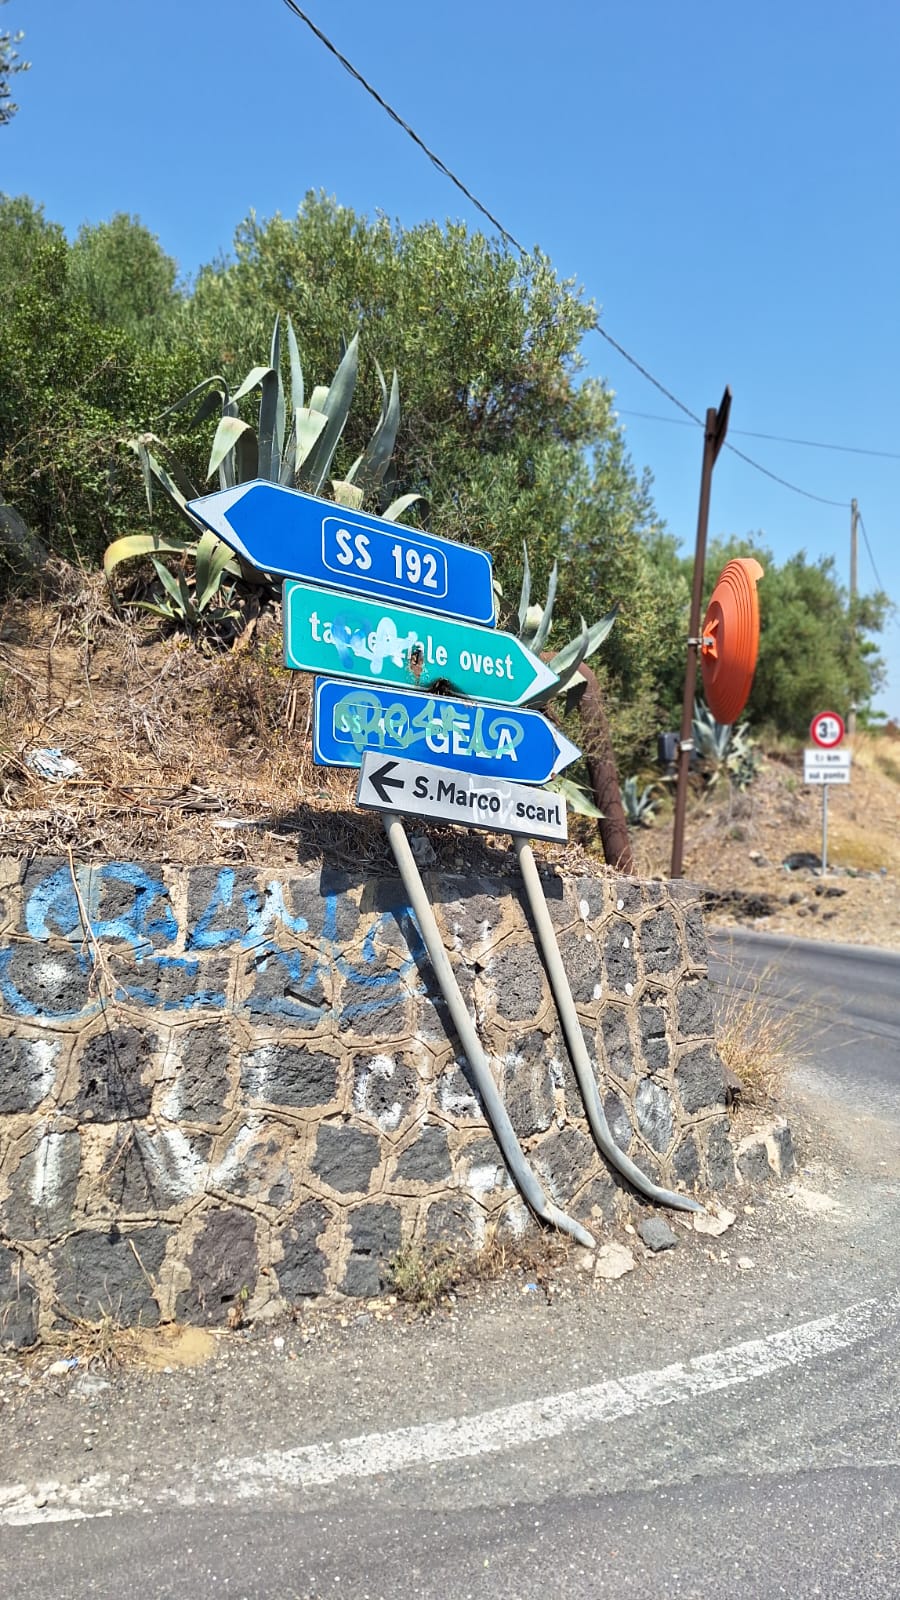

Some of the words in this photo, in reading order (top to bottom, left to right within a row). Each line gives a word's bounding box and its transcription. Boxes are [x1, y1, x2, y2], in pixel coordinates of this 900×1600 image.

[336, 529, 372, 570] SS
[392, 544, 438, 589] 192
[460, 650, 514, 680] ovest
[425, 718, 518, 762] GELA
[412, 775, 501, 813] S.Marco
[516, 801, 561, 826] scarl
